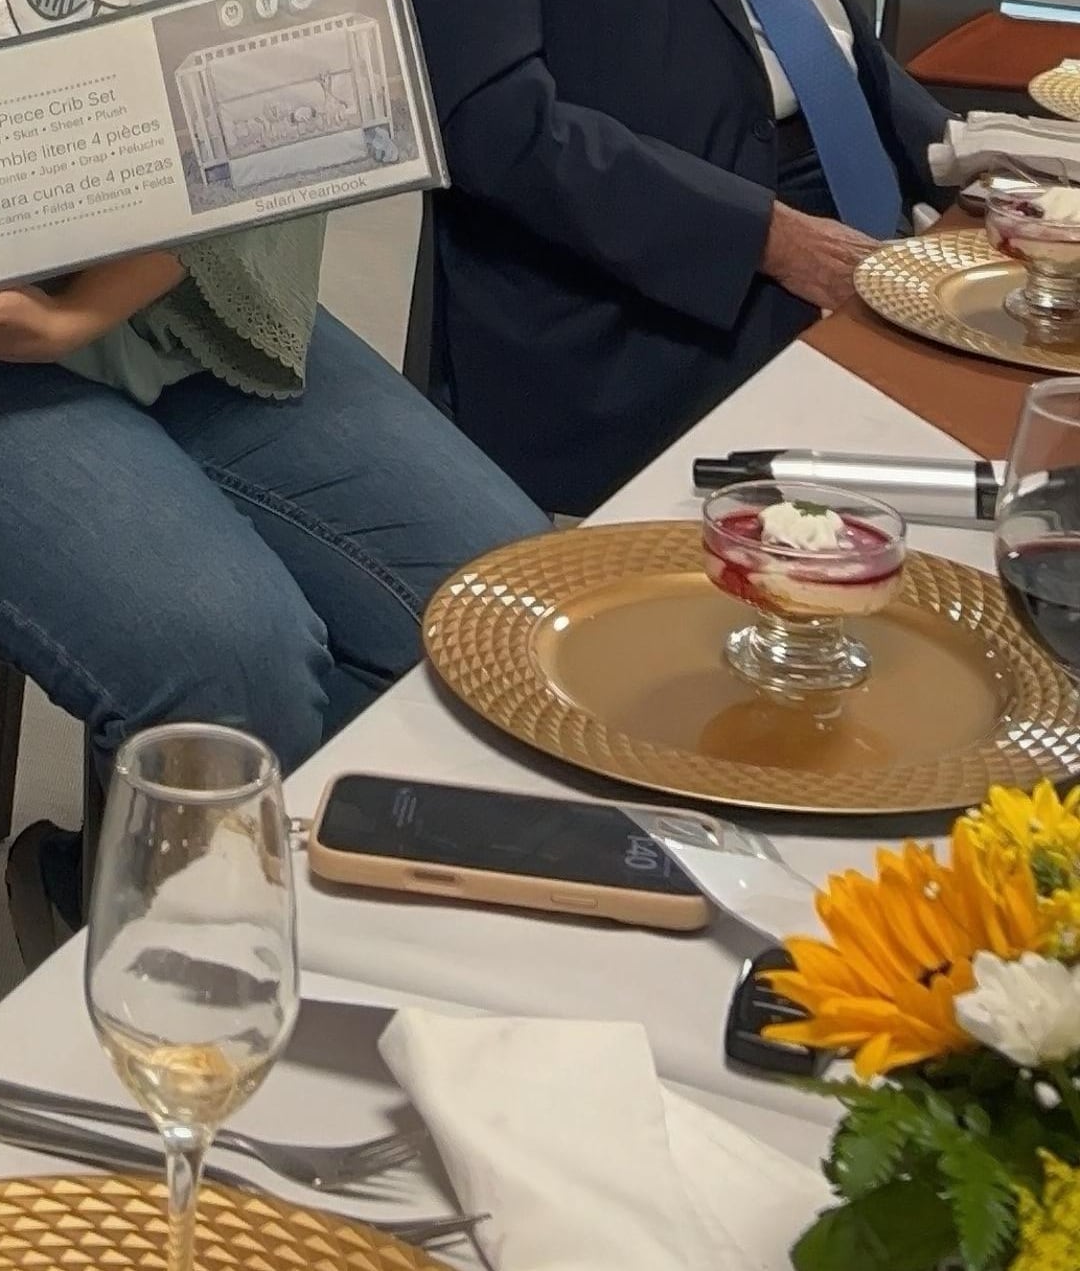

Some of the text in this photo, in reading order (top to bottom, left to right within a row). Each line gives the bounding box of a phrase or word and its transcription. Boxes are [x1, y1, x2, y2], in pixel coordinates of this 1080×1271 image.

[48, 96, 84, 116] Crib
[87, 89, 116, 106] Set
[41, 138, 88, 159] literie
[91, 131, 102, 145] 4
[106, 119, 160, 146] pièces
[39, 162, 68, 177] Jupe
[79, 152, 109, 166] Drap
[32, 182, 76, 202] cuna
[79, 174, 102, 191] de
[105, 168, 116, 183] 4
[120, 157, 174, 183] piezas
[298, 176, 368, 202] Yearbook
[42, 199, 76, 215] Falda
